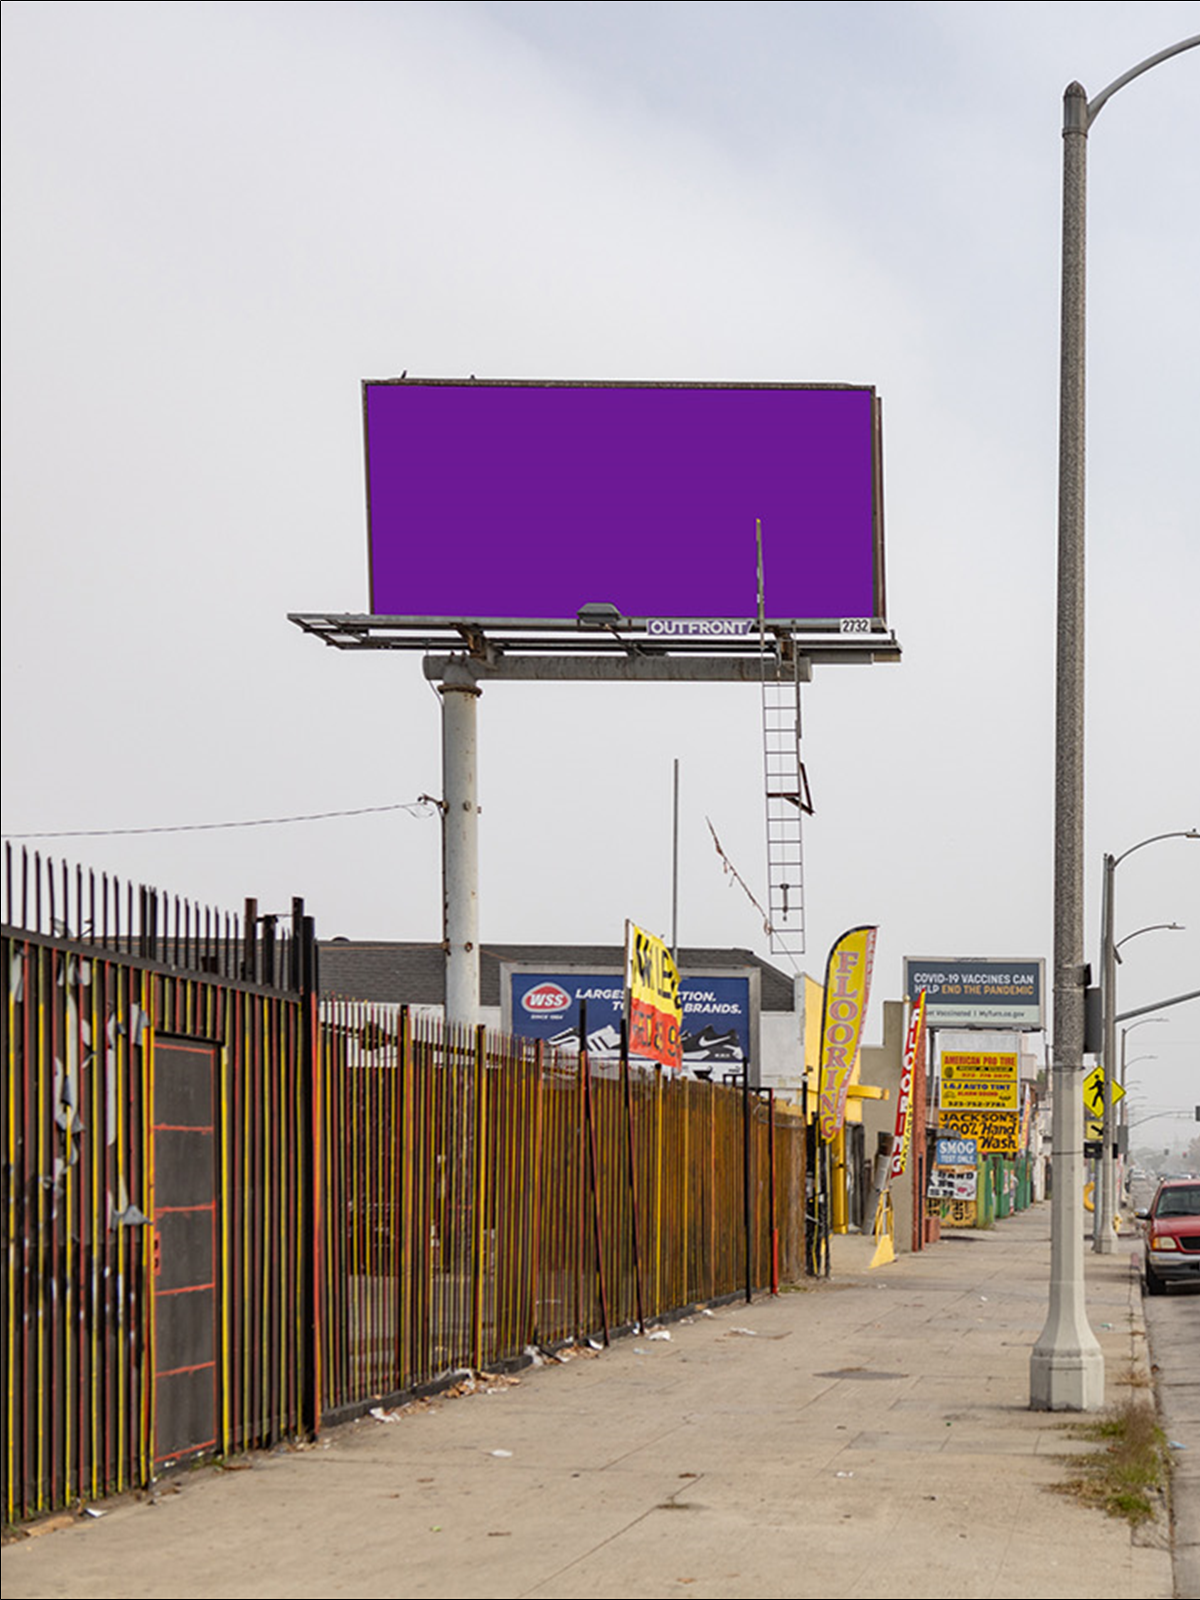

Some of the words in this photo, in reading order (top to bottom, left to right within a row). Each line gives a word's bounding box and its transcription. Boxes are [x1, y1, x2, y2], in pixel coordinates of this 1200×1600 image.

[650, 620, 748, 635] OUTFRONT
[842, 619, 869, 632] 2732
[913, 972, 960, 984] COVID-19
[961, 973, 1011, 985] VACCINES
[1012, 974, 1034, 985] CAN
[941, 984, 962, 995] END
[963, 985, 982, 996] THE
[983, 985, 1034, 996] PANDEMIC
[530, 993, 564, 1006] WSS
[684, 1003, 742, 1014] BRANDS.
[819, 951, 860, 1139] FLOORING
[944, 1056, 981, 1065] AMERICAN
[999, 1056, 1015, 1066] TIRE
[892, 1007, 921, 1174] FLOORING
[940, 1112, 1017, 1122] JACKSON'S
[979, 1121, 1017, 1136] Hand
[940, 1141, 975, 1154] SMOG
[979, 1136, 1017, 1149] Wash
